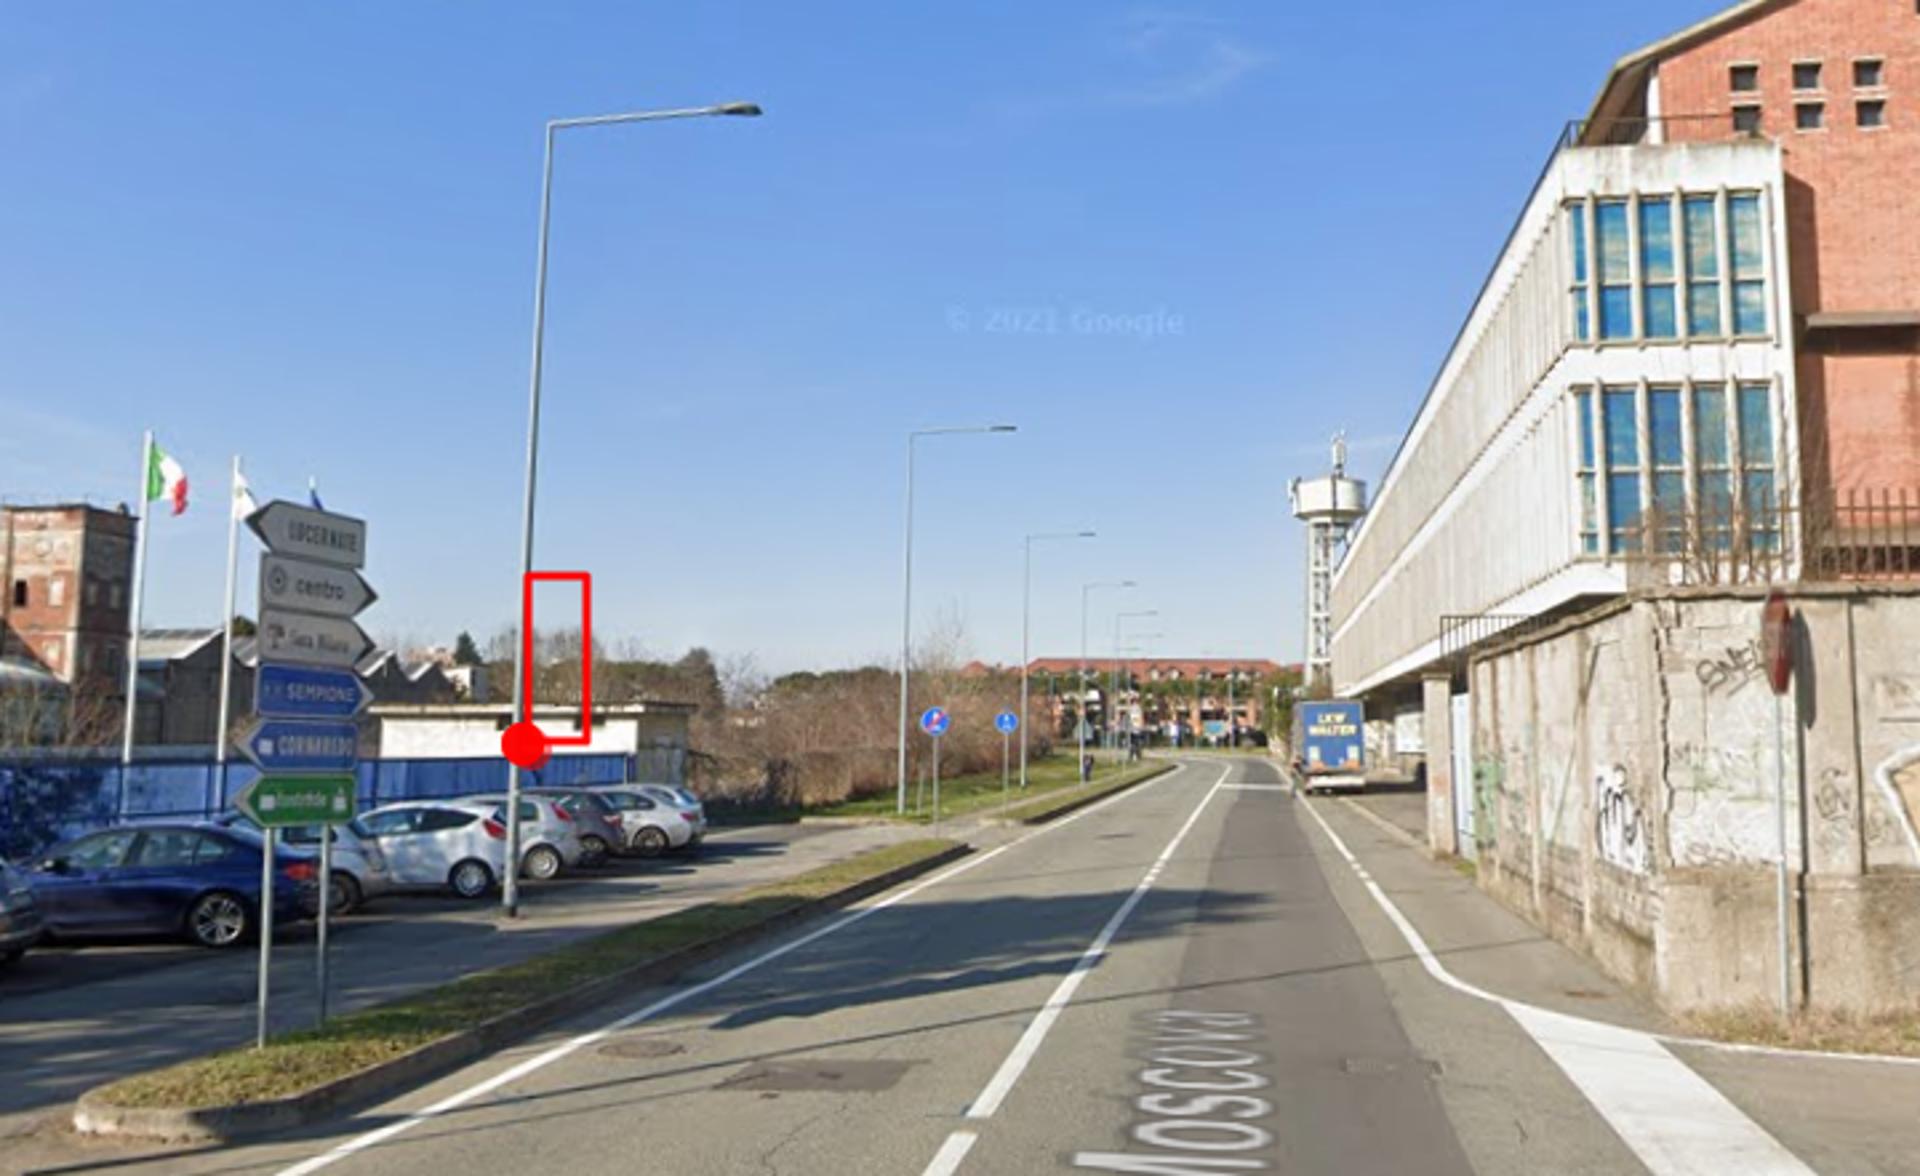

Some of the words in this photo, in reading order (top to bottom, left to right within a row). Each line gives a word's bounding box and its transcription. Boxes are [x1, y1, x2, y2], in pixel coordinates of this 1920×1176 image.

[296, 578, 345, 600] centro
[287, 683, 355, 702] SEMPIONE
[1317, 711, 1347, 724] LKW
